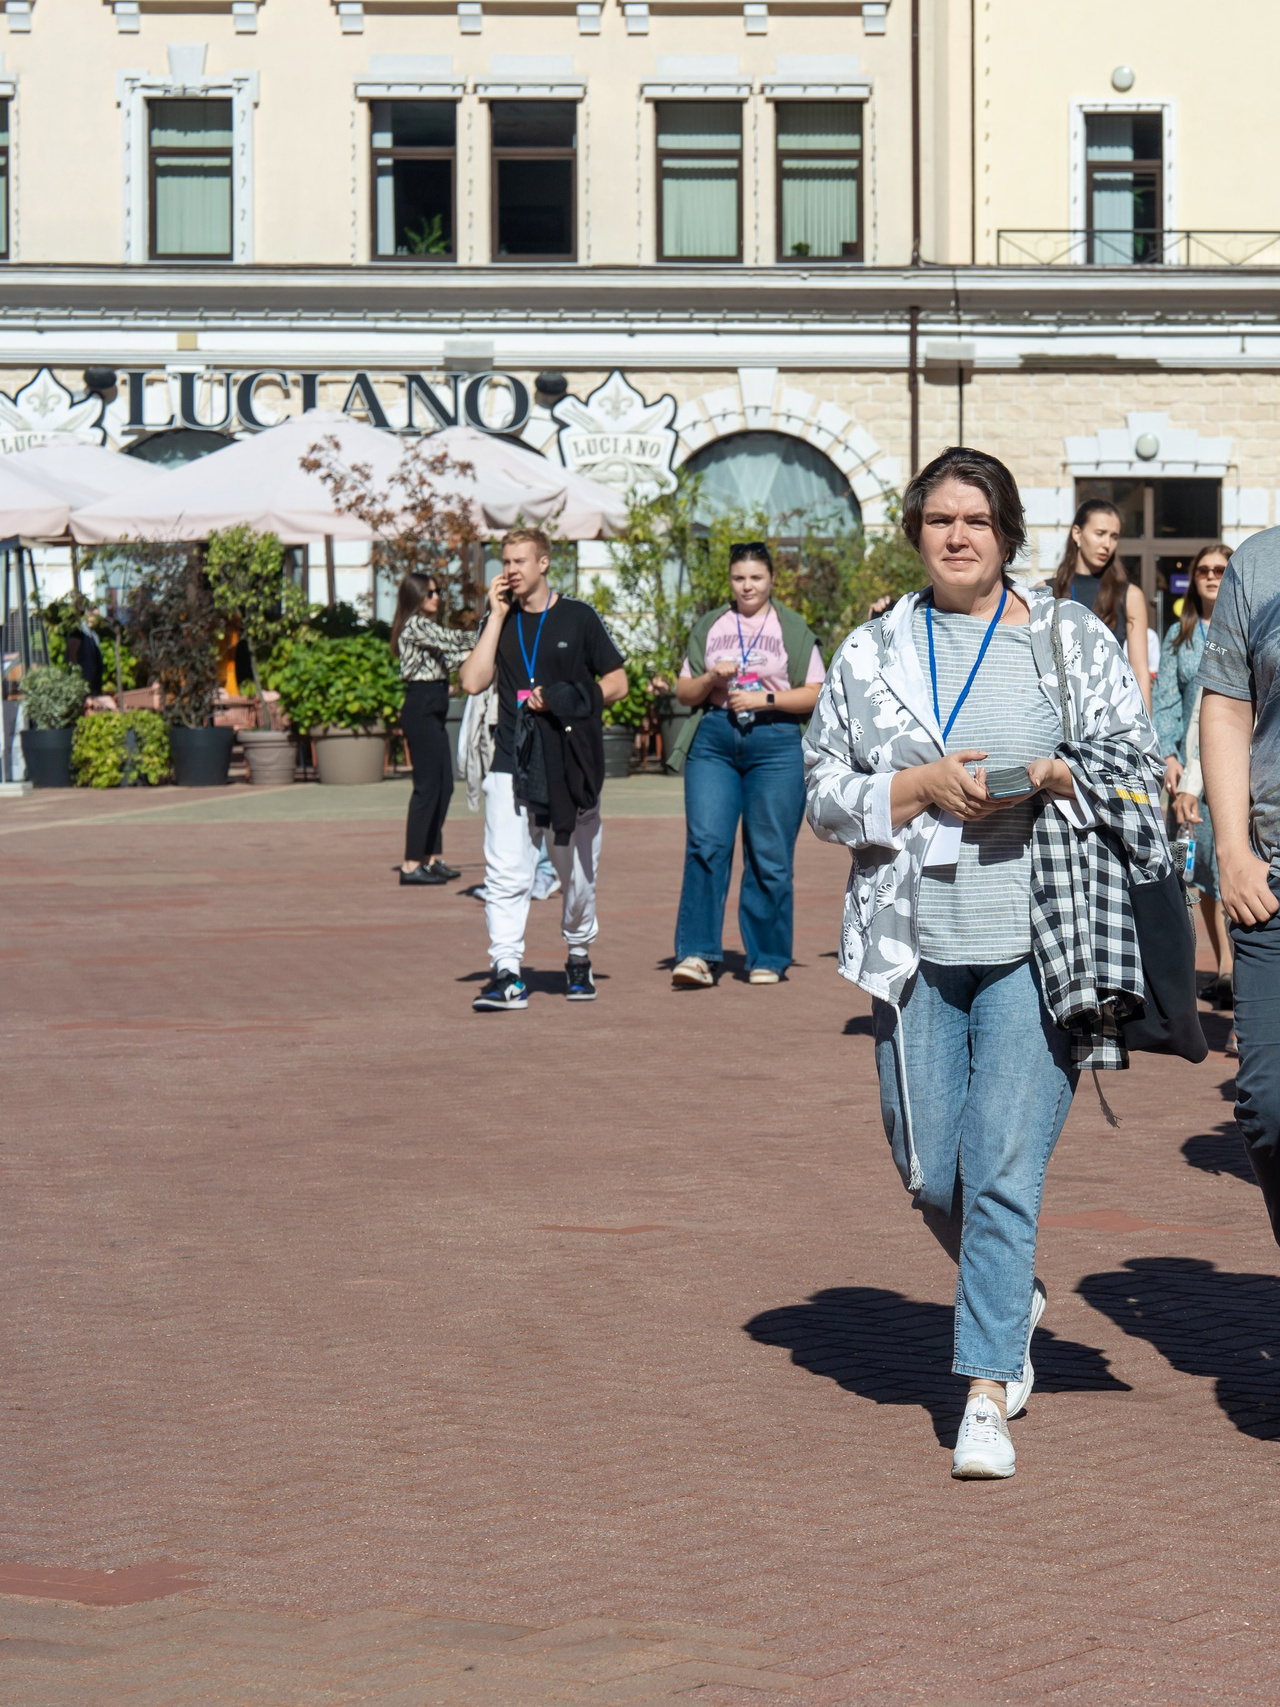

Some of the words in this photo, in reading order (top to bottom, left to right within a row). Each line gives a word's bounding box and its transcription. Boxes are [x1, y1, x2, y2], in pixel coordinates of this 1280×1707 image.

[120, 369, 530, 434] LUCIANO
[1, 434, 47, 455] LUC
[572, 437, 661, 459] LUCIANO
